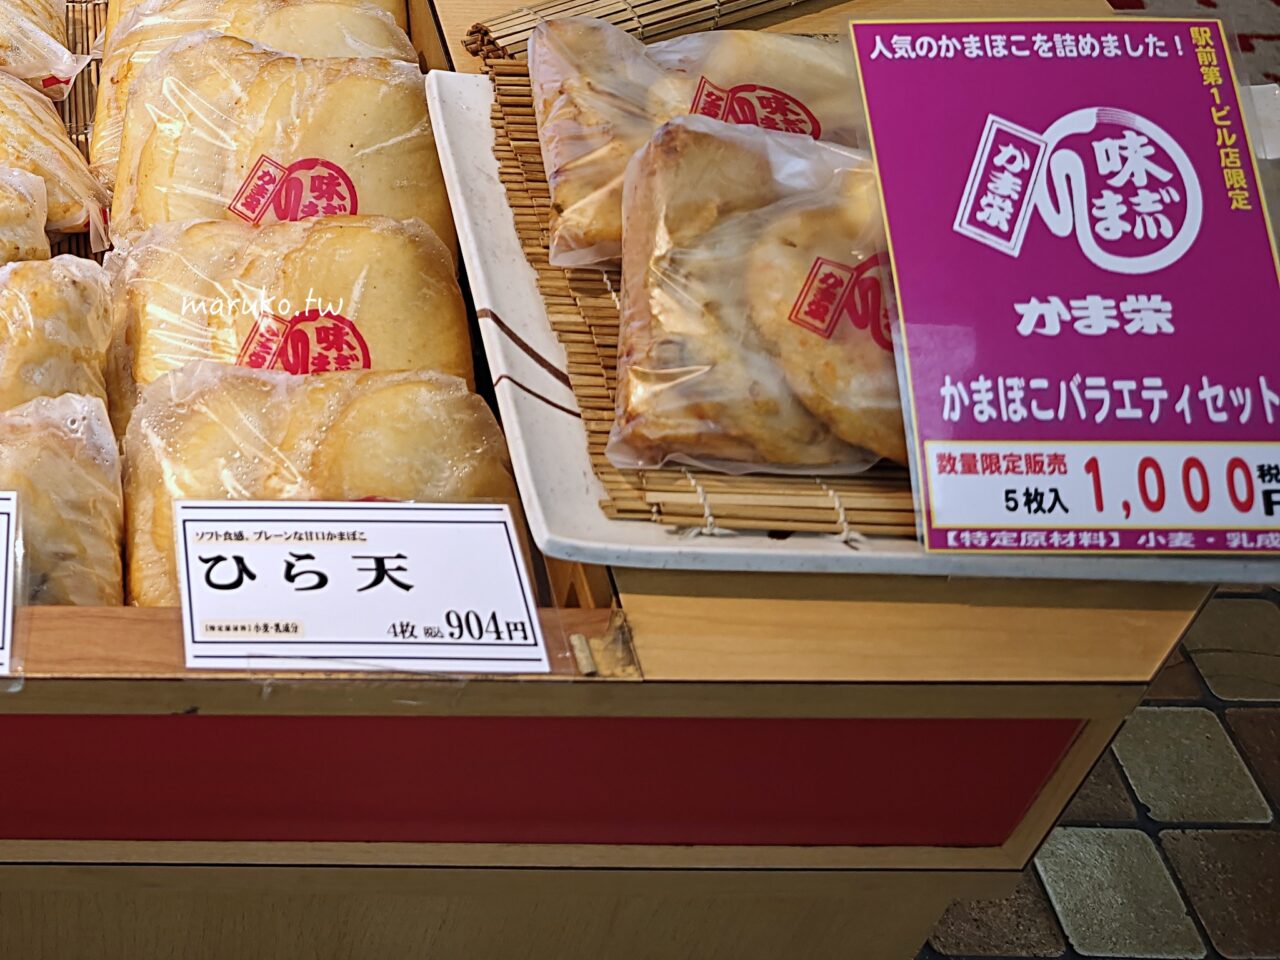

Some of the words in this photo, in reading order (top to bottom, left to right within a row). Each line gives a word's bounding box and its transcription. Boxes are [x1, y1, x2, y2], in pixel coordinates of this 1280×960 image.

[869, 34, 1184, 60] 人気のかまぼこを詰めました！
[1190, 26, 1251, 210] 駅前第1ビル店限定
[975, 143, 1030, 233] かま栄
[1014, 295, 1175, 337] かま栄
[940, 373, 1280, 425] かまぼこバラエティセット
[936, 452, 1068, 476] 数量限定販売
[1005, 488, 1070, 514] 5枚入
[1084, 456, 1255, 519] 1,000
[197, 551, 415, 592] ひら天
[445, 609, 528, 642] 904円
